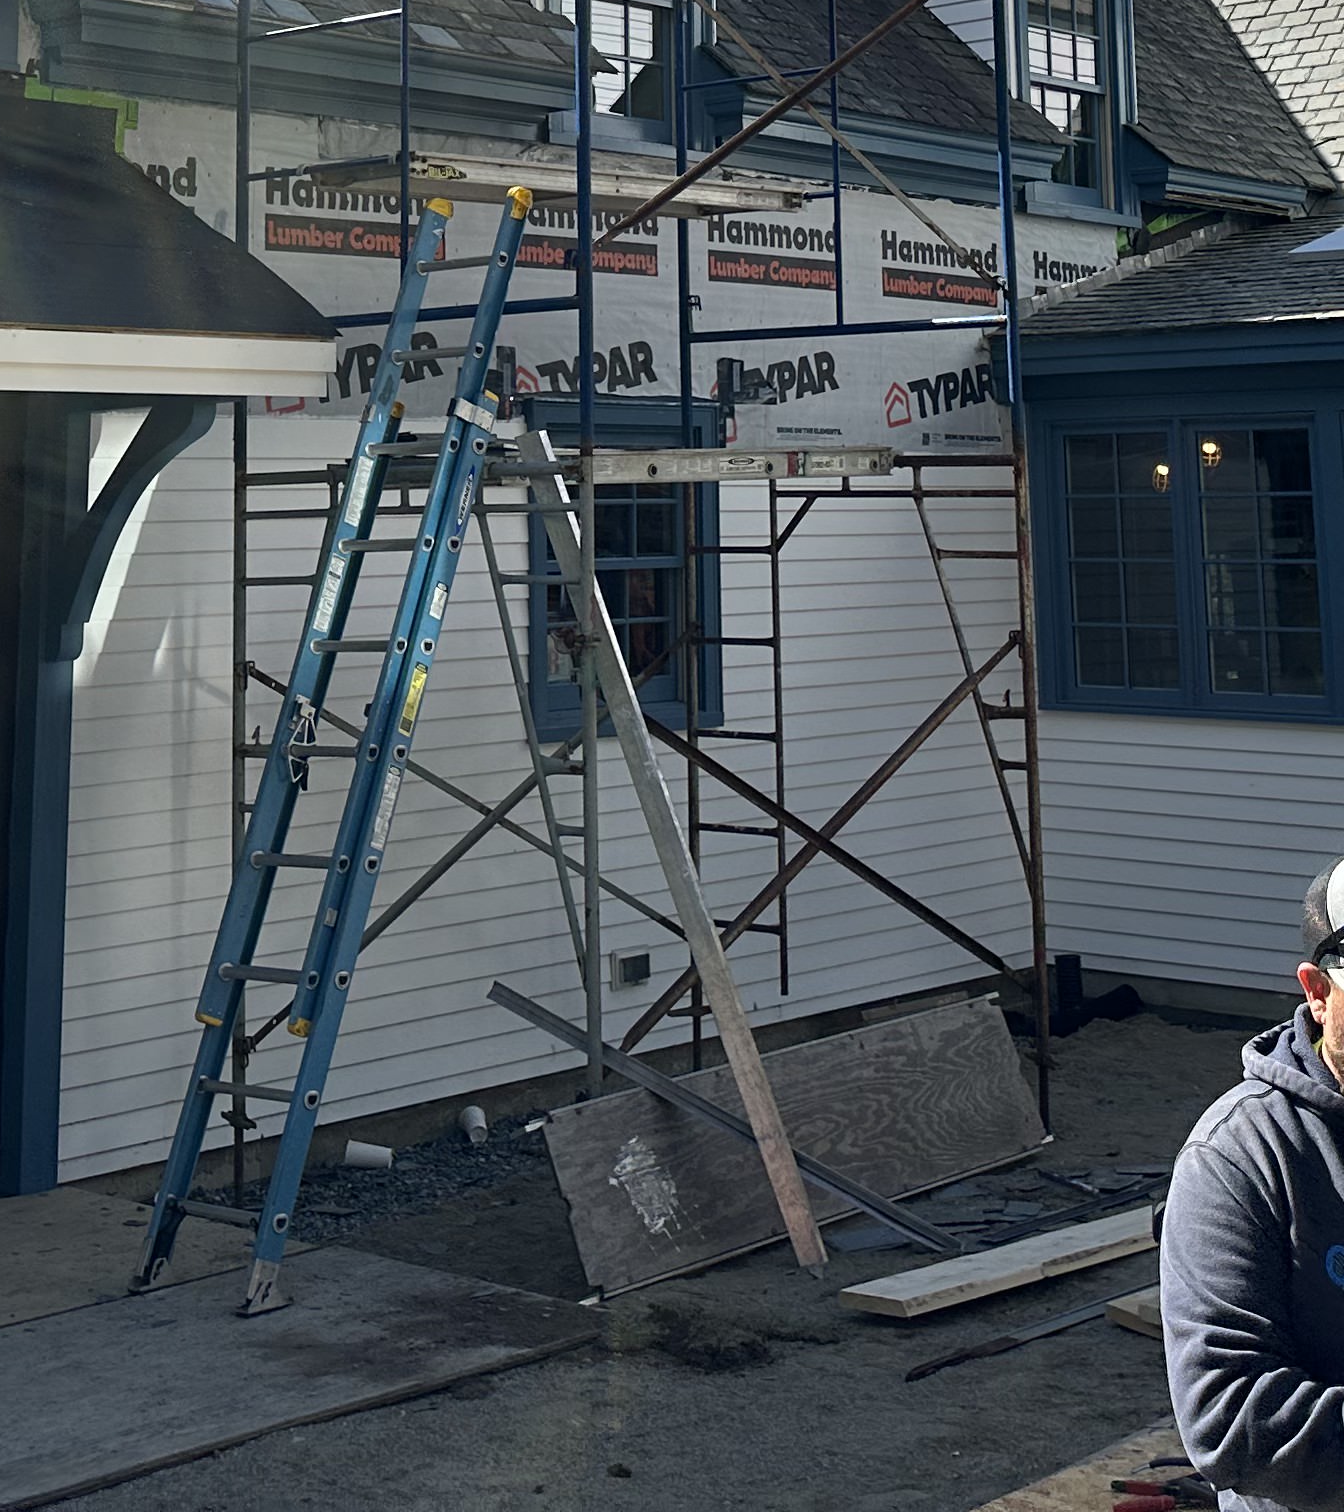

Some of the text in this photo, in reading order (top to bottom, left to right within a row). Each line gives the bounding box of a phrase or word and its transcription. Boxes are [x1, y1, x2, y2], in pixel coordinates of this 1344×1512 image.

[266, 220, 344, 250] Lumber
[880, 229, 998, 273] Hammond
[709, 255, 837, 289] Lumber Company
[883, 269, 997, 306] Lumber Company
[318, 331, 444, 404] YPR
[536, 341, 659, 393] TYPAR
[907, 363, 997, 419] TYPAR
